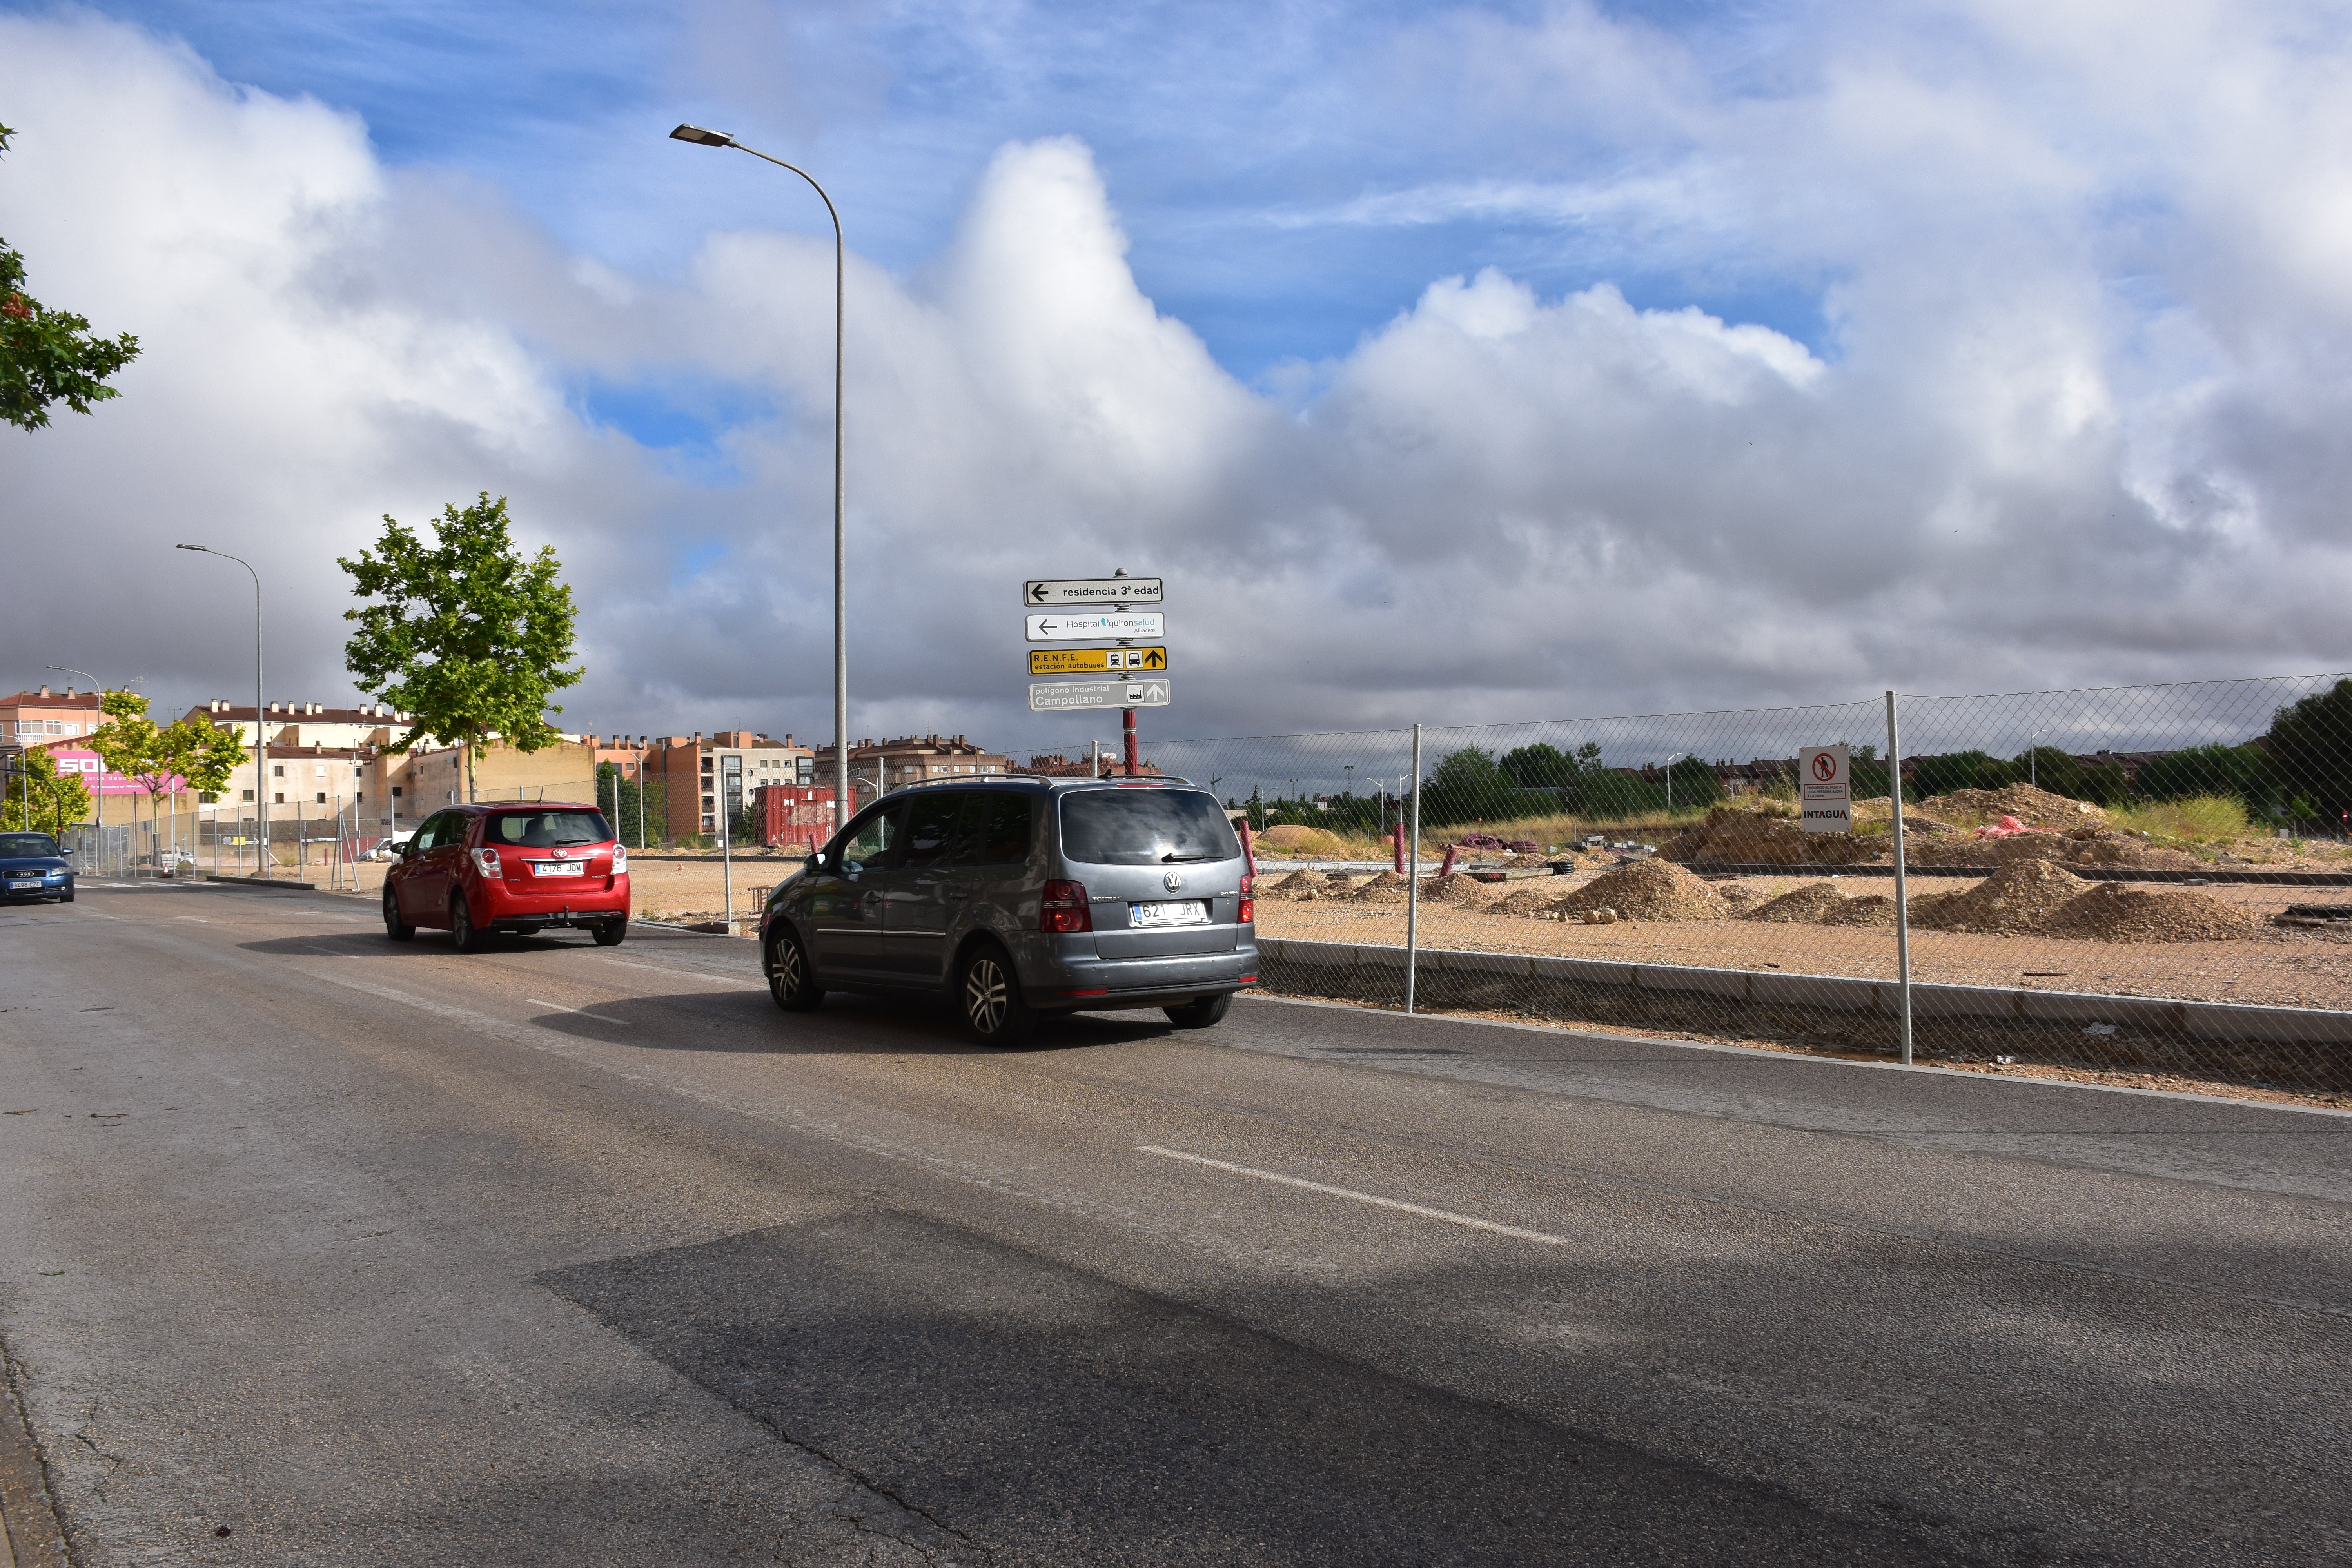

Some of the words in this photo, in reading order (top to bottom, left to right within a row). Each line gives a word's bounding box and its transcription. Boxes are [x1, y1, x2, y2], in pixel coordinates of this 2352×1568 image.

[1063, 587, 1116, 597] residencia
[1134, 586, 1159, 595] edad
[1067, 620, 1099, 629] Hospital
[1109, 618, 1155, 628] quirónsalud
[1035, 686, 1069, 695] polígono
[1036, 695, 1103, 706] Campollano
[1804, 810, 1848, 820] INTAGUA
[543, 864, 562, 872] 4176
[567, 864, 581, 872] JDM
[1180, 903, 1200, 916] JRX
